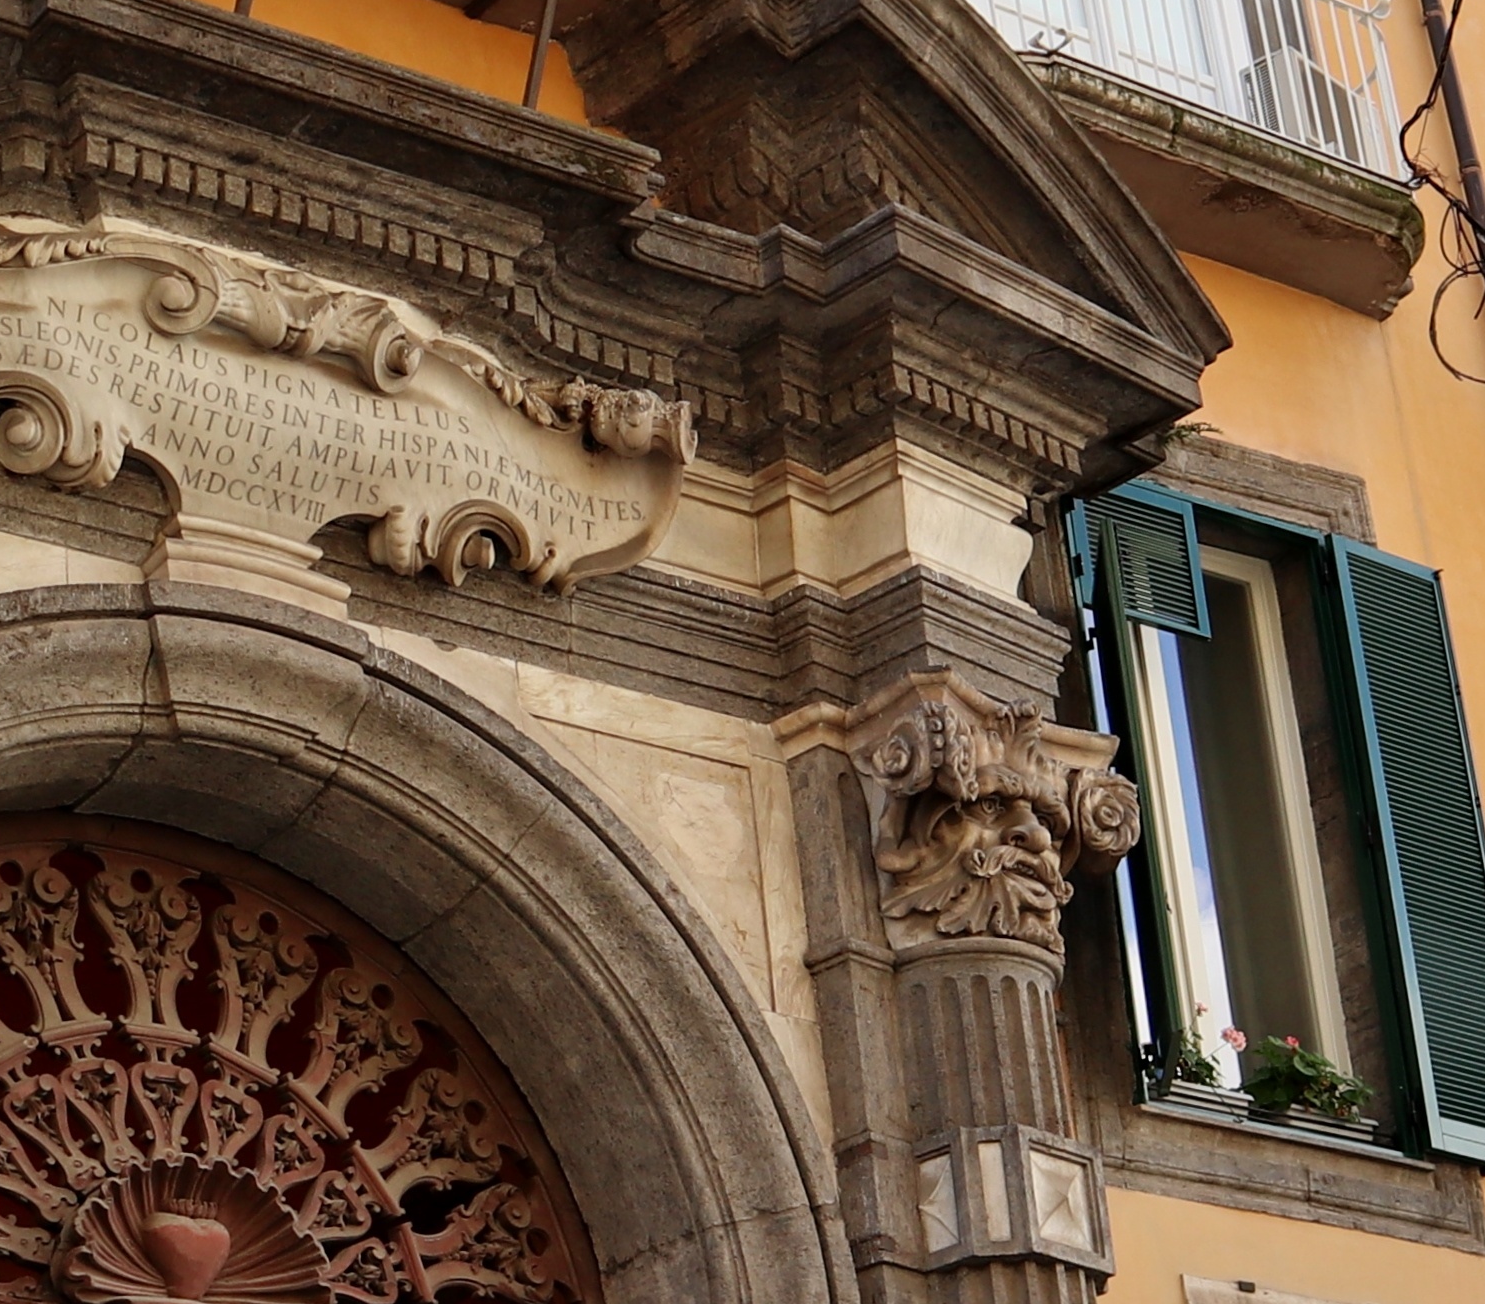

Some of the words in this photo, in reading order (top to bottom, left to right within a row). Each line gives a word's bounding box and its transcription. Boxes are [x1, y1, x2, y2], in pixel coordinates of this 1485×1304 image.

[15, 344, 101, 387] ÆDES
[46, 296, 229, 377] NICOLAUS
[244, 362, 471, 435] PIGNATELLUS
[128, 354, 276, 420] PRIMORES
[282, 403, 366, 446] INTER
[139, 423, 235, 467] ANNO
[247, 453, 381, 506] SALUTIS
